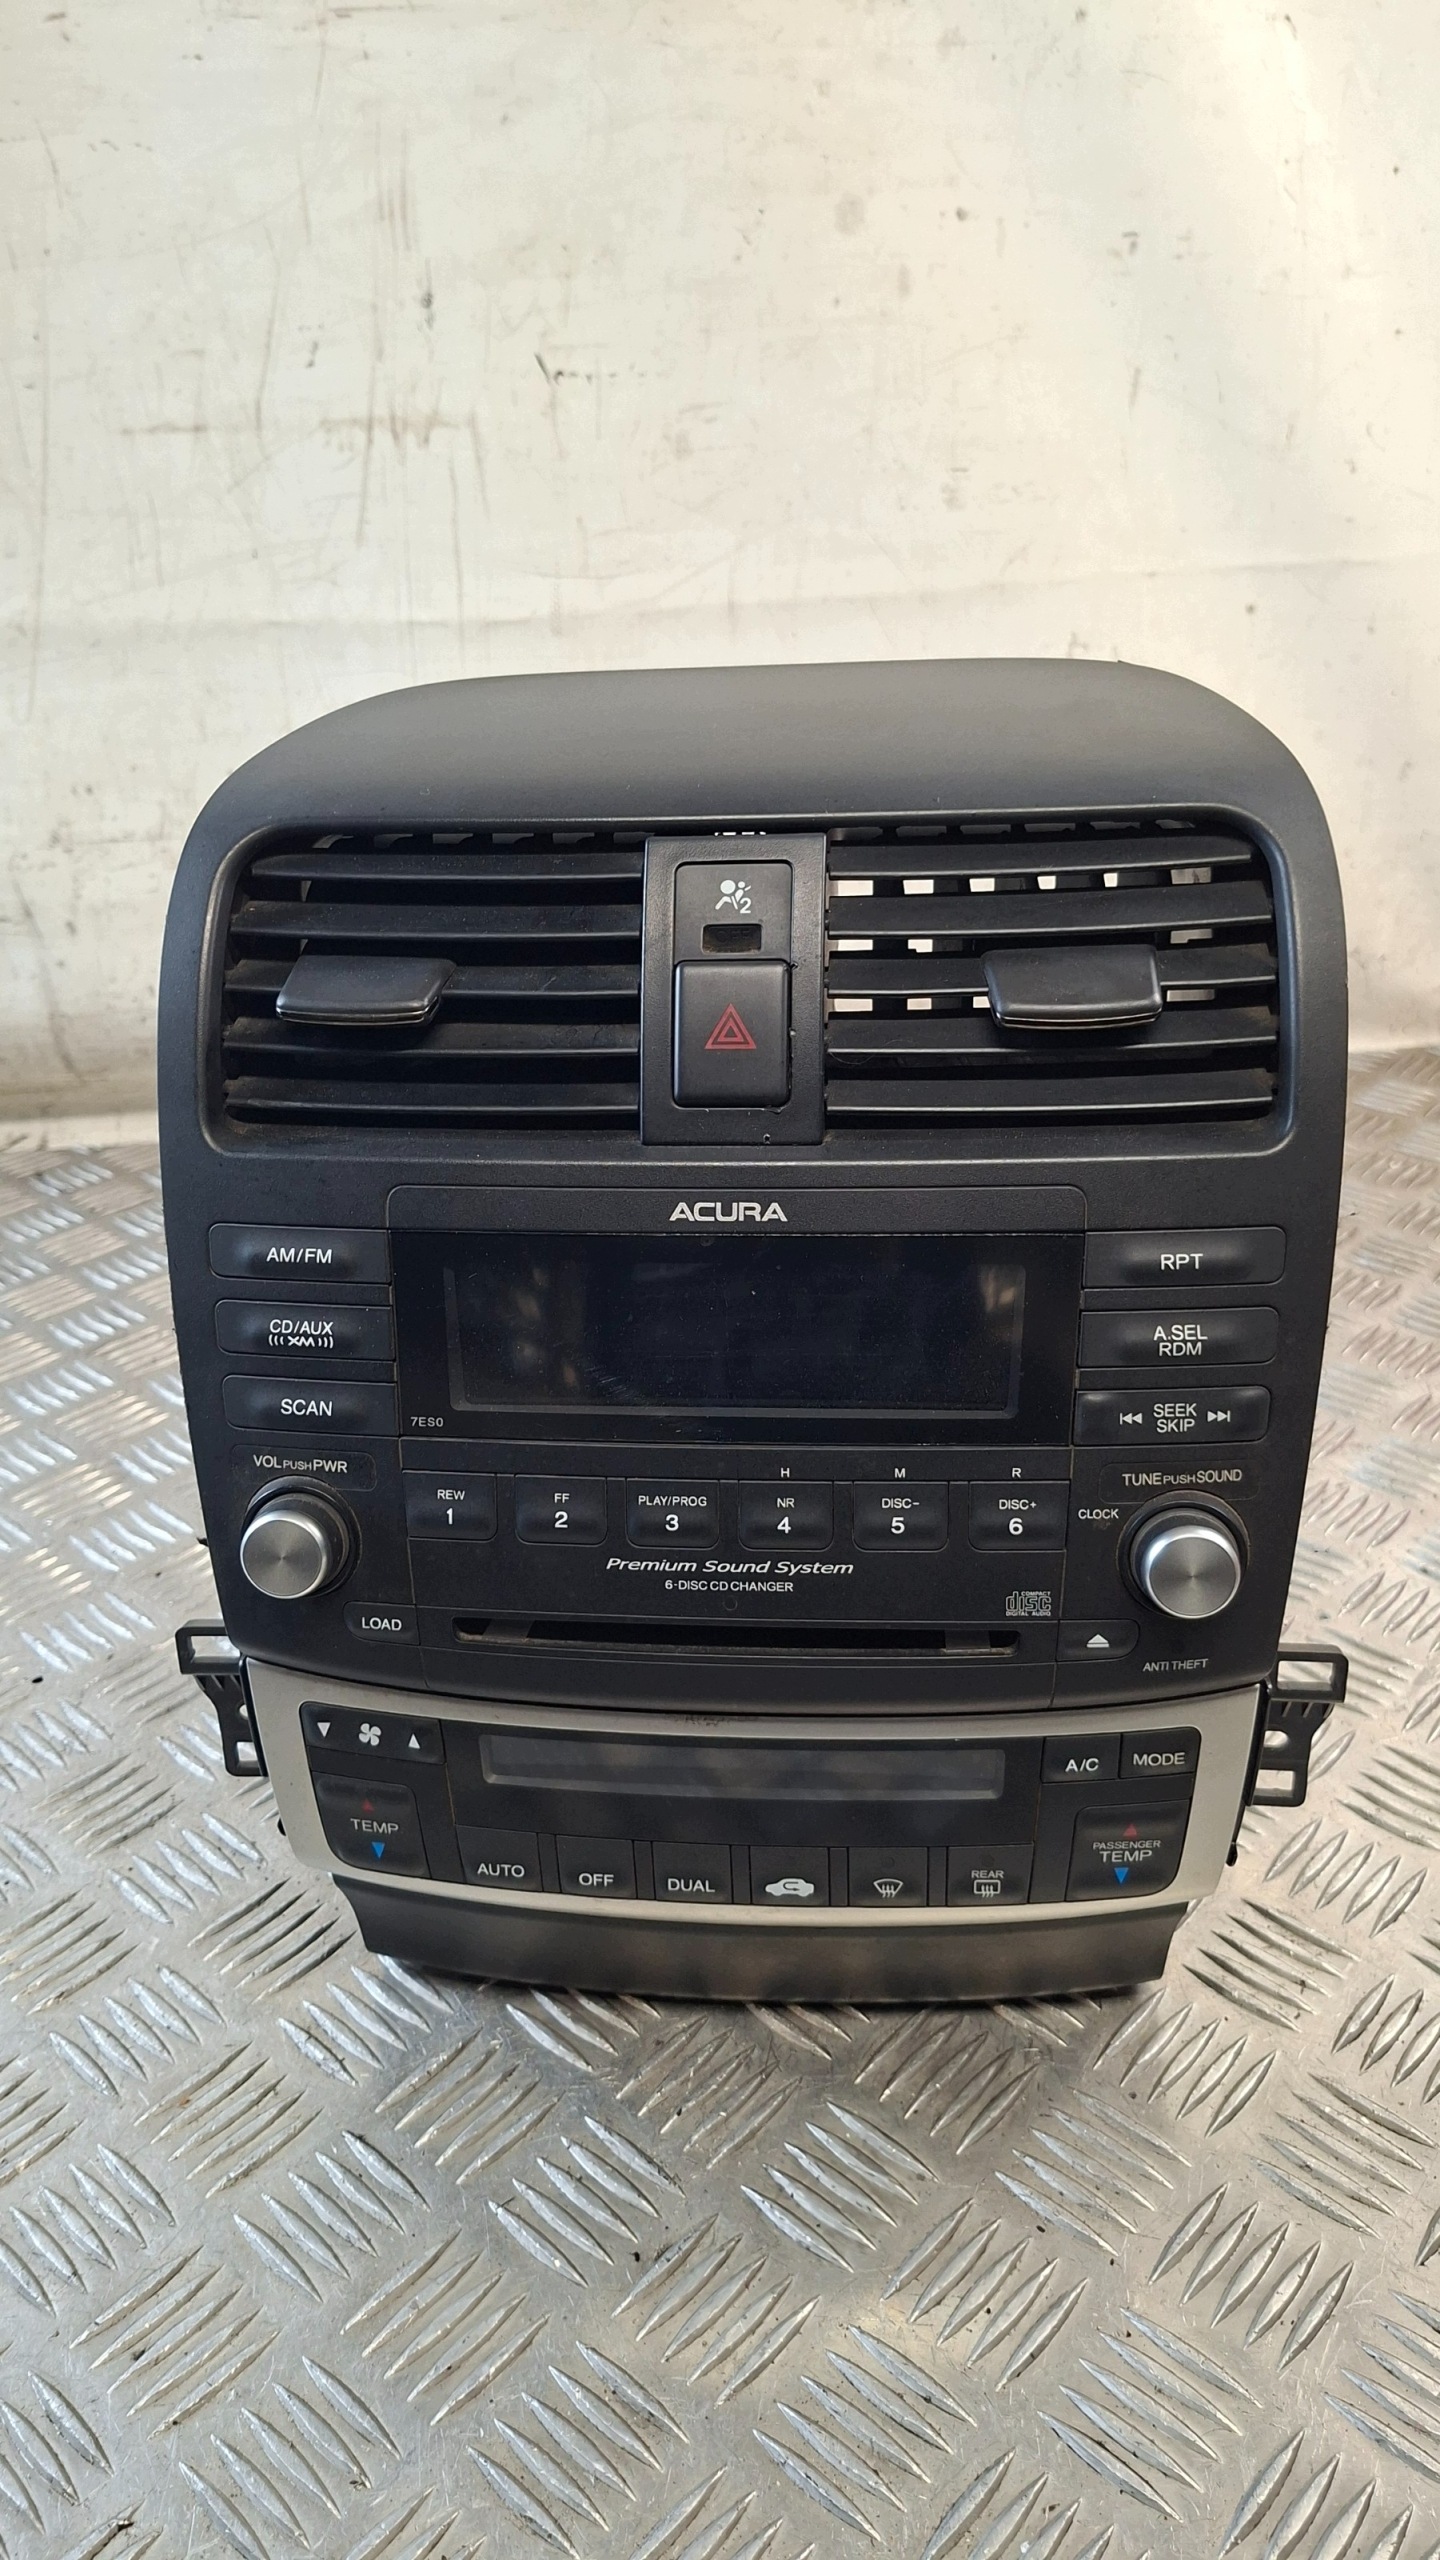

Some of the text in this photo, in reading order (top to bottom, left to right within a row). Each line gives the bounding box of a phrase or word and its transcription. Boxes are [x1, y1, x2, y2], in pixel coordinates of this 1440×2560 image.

[668, 1201, 788, 1222] ACURA
[266, 1246, 333, 1264] AM/FM
[1160, 1252, 1204, 1270] RPT
[268, 1318, 334, 1336] CD/AUX
[1153, 1324, 1209, 1342] A.SEL
[1159, 1341, 1202, 1357] RDM
[280, 1398, 333, 1417] SCAN
[1153, 1402, 1198, 1419] SEEK
[1156, 1418, 1196, 1434] SKIP
[253, 1454, 348, 1474] VOL PUSH PWR
[780, 1467, 791, 1479] H
[894, 1467, 906, 1479] M
[1011, 1467, 1022, 1478] R
[1121, 1468, 1243, 1487] TUNE PUSH SOUND
[437, 1489, 466, 1501] REW
[554, 1492, 570, 1504] FF
[638, 1495, 707, 1507] PLAY/PROG
[776, 1497, 795, 1509] NR
[998, 1499, 1037, 1511] DISC+
[446, 1507, 453, 1525] 1
[554, 1510, 568, 1529] 2
[1077, 1508, 1119, 1520] CLOCK
[665, 1513, 679, 1532] 3
[777, 1516, 792, 1534] 4
[890, 1516, 905, 1535] 5
[1008, 1517, 1024, 1535] 6
[606, 1557, 854, 1577] Premium Sound System
[664, 1579, 794, 1592] 6-DISC CD CHANGER
[1006, 1591, 1051, 1611] disc
[361, 1616, 402, 1631] LOAD
[1142, 1658, 1209, 1672] ANTI THEFT
[1065, 1757, 1099, 1773] A/C
[1133, 1752, 1186, 1767] MODE
[350, 1818, 399, 1835] TEMP
[1092, 1839, 1162, 1851] PASSENGER
[1099, 1849, 1154, 1864] TEMP
[477, 1862, 525, 1878] AUTO
[971, 1869, 1005, 1880] REAR
[578, 1872, 614, 1887] OFF
[667, 1878, 716, 1893] DUAL
